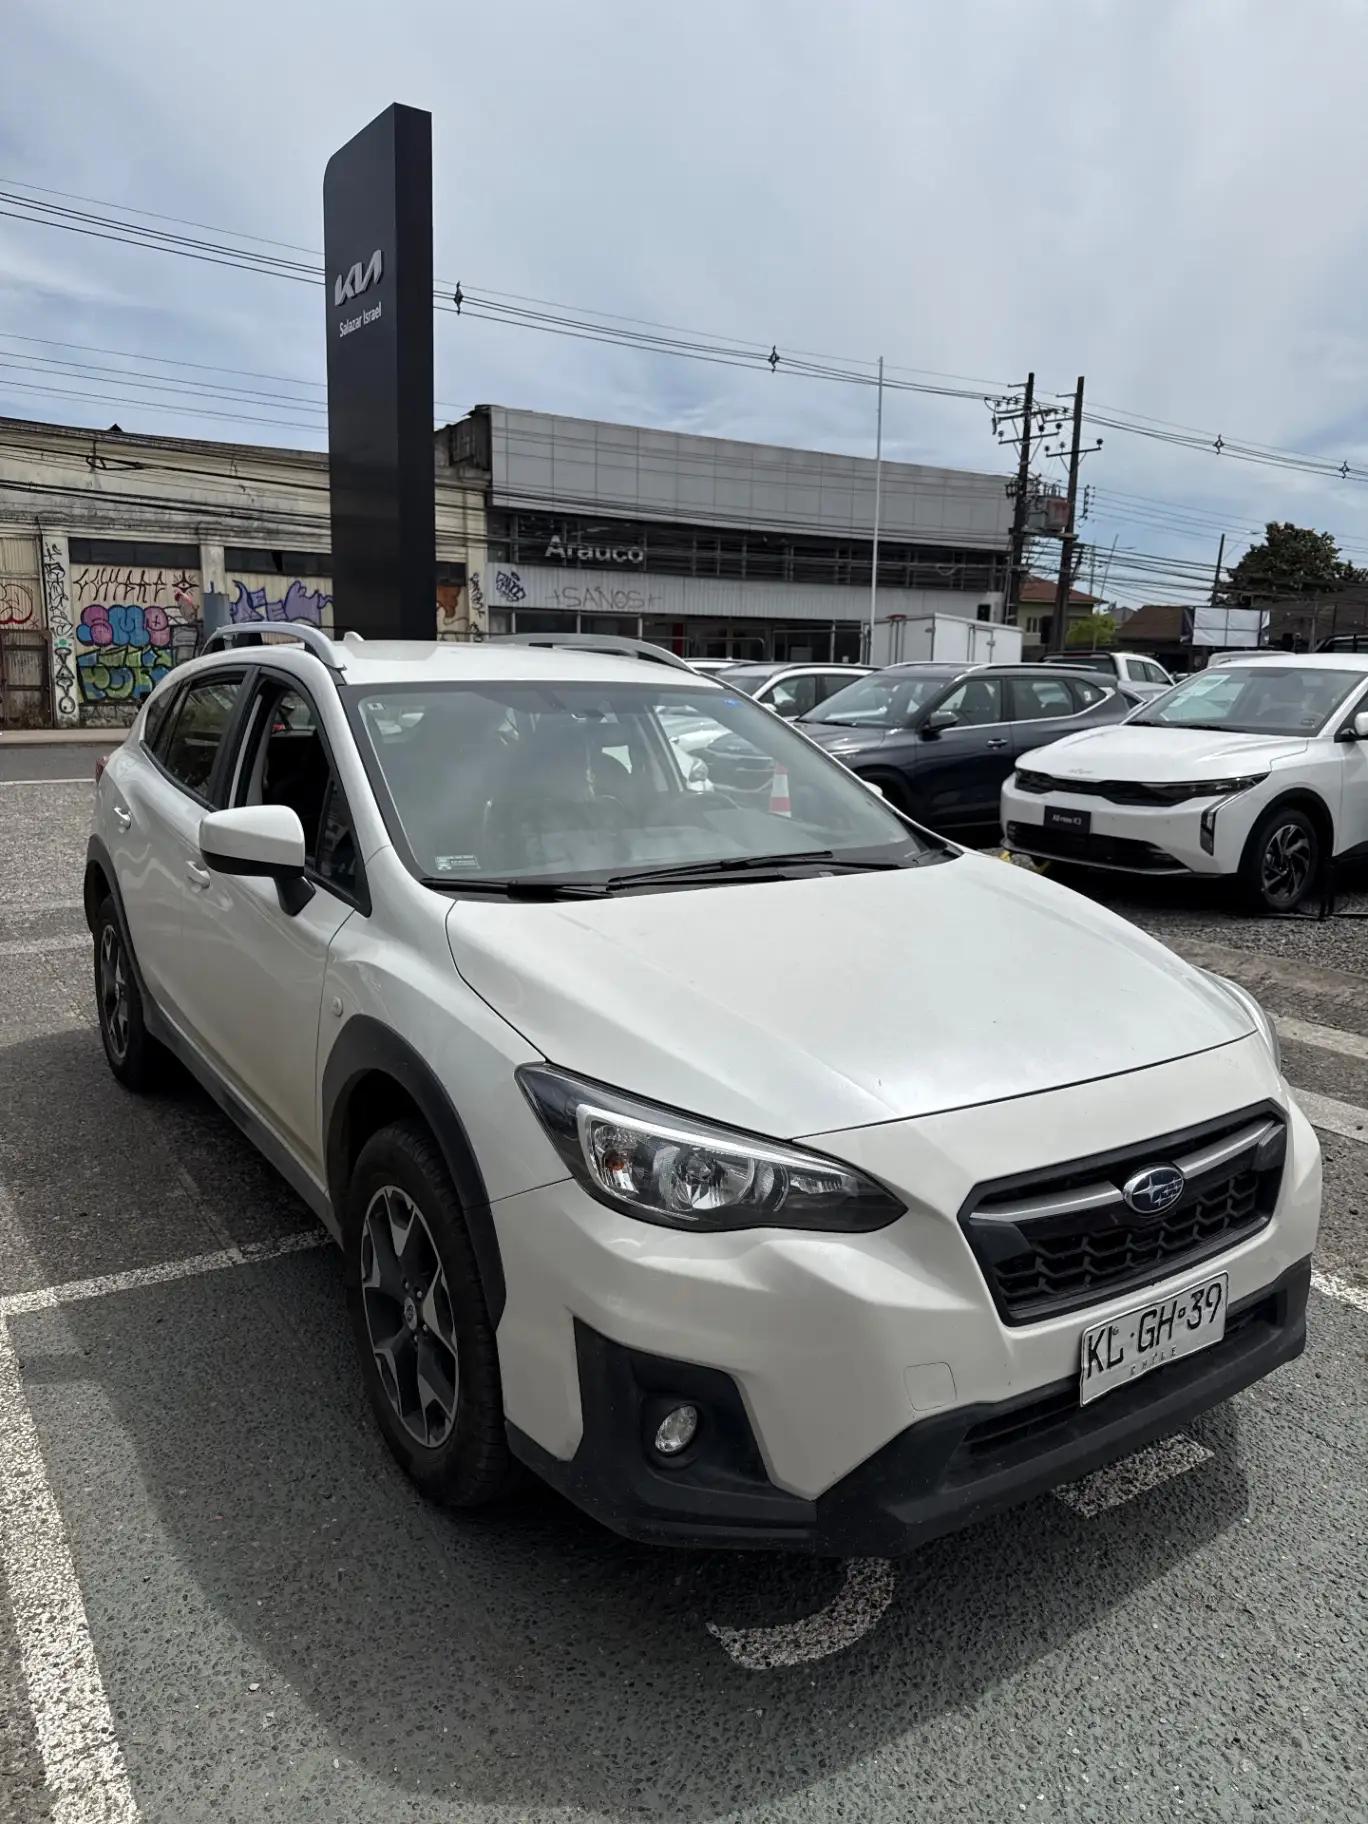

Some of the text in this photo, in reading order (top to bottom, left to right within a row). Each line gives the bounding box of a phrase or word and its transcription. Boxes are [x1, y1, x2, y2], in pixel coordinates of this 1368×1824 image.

[339, 301, 382, 338] Salazar Israel
[544, 534, 644, 564] Arauco
